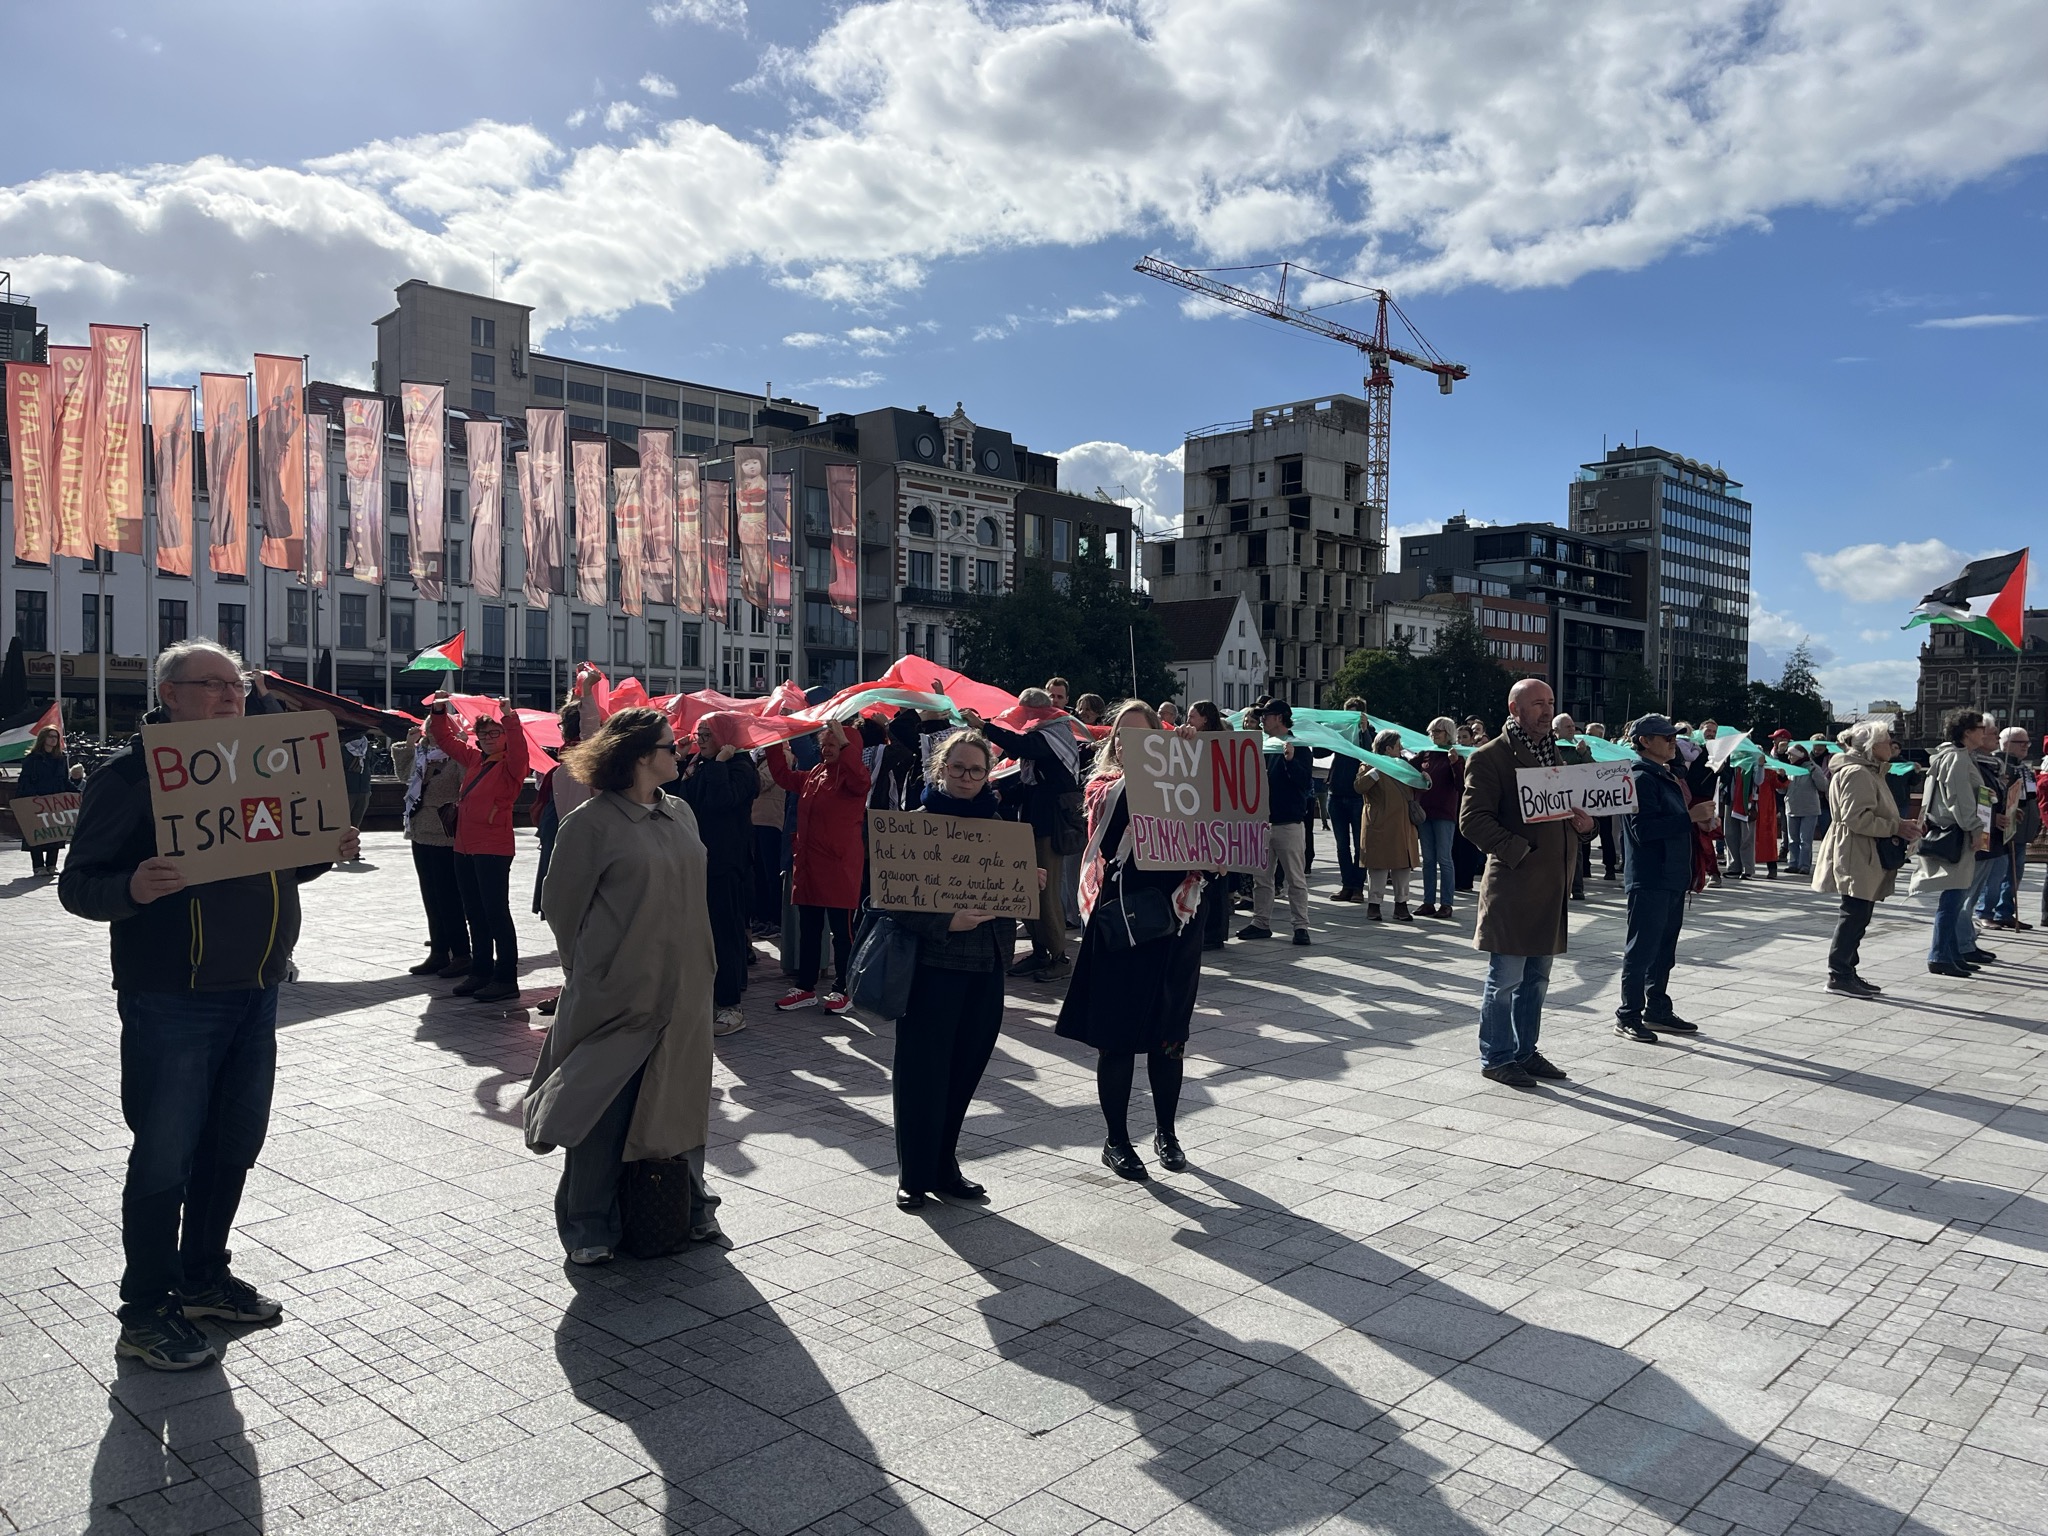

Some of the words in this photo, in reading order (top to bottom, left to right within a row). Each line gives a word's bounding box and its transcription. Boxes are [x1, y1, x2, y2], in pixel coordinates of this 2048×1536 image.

[110, 658, 143, 669] Quality
[152, 731, 330, 792] BOYCOTT
[1143, 734, 1204, 778] SAY
[1210, 737, 1261, 815] NO
[1595, 765, 1630, 781] Everyday
[1153, 781, 1201, 816] TO
[1520, 785, 1573, 818] BOYCOTT
[1581, 787, 1633, 808] ISRAEL
[161, 791, 341, 857] ISRAËL
[923, 821, 939, 837] De
[874, 839, 896, 860] het
[901, 843, 916, 861] is
[923, 844, 942, 862] ook
[950, 852, 971, 864] een
[978, 850, 1005, 873] optie
[1012, 860, 1028, 871] om
[1131, 813, 1272, 871] PINKWASHING
[877, 869, 920, 891] gewoon
[924, 873, 942, 887] niet
[967, 875, 1006, 892] irritant
[1012, 879, 1026, 893] te
[881, 888, 909, 906] doen
[981, 891, 1000, 903] had
[1011, 894, 1027, 904] dat
[974, 903, 988, 911] niet
